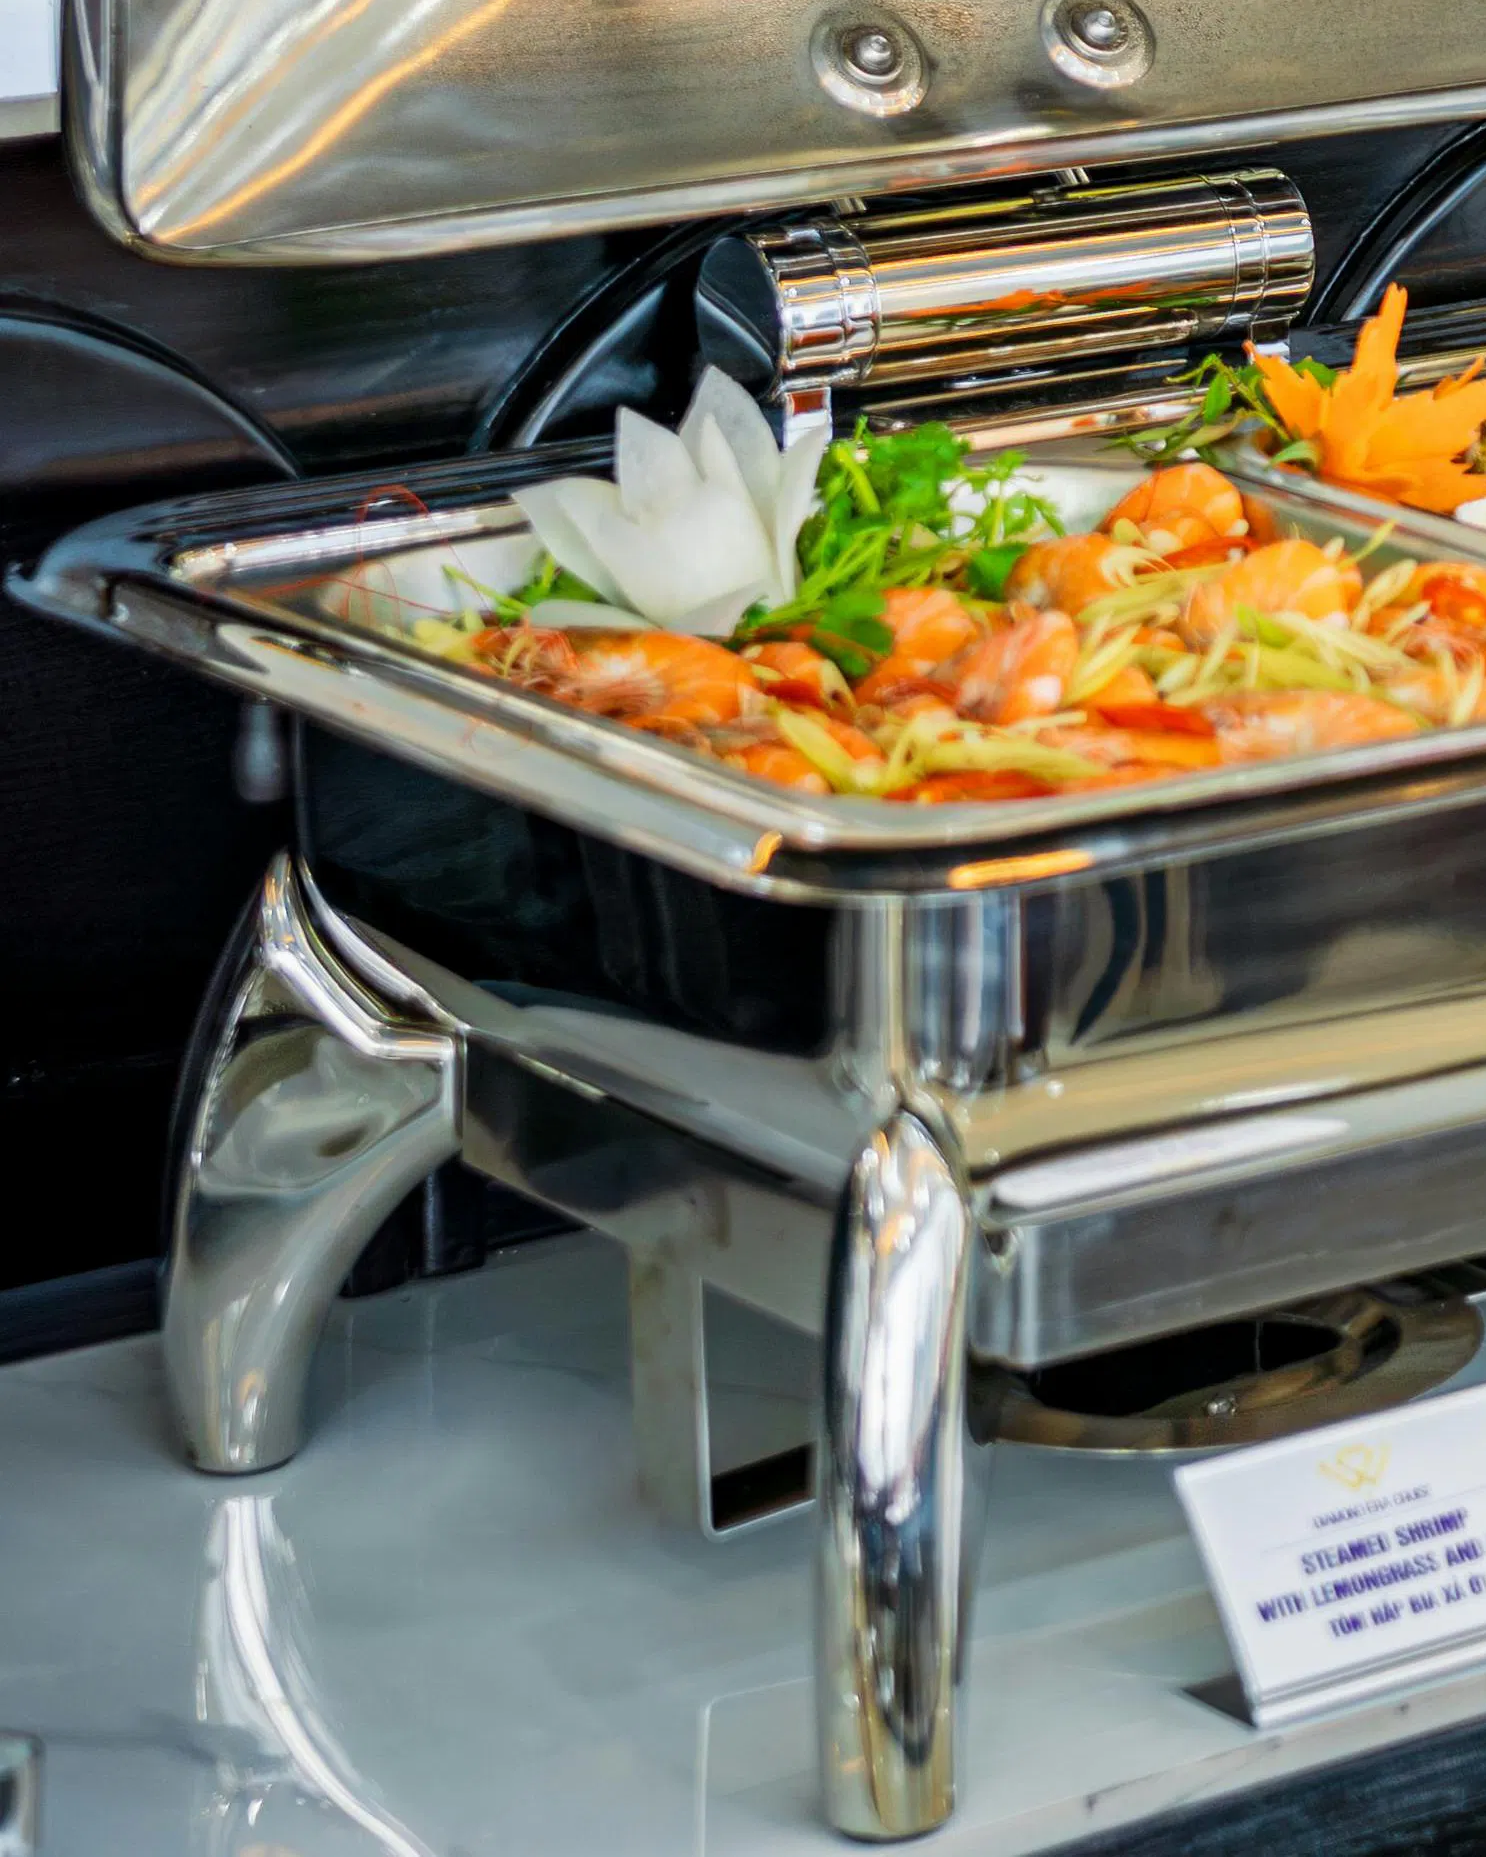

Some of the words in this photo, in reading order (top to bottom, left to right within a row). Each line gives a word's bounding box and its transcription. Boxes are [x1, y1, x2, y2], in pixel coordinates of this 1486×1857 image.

[1301, 1533, 1391, 1575] STEAMED
[1395, 1507, 1468, 1547] SHRIMP
[1256, 1590, 1307, 1622] WITH
[1311, 1551, 1440, 1607] LEMONGRASS
[1446, 1538, 1483, 1567] AND
